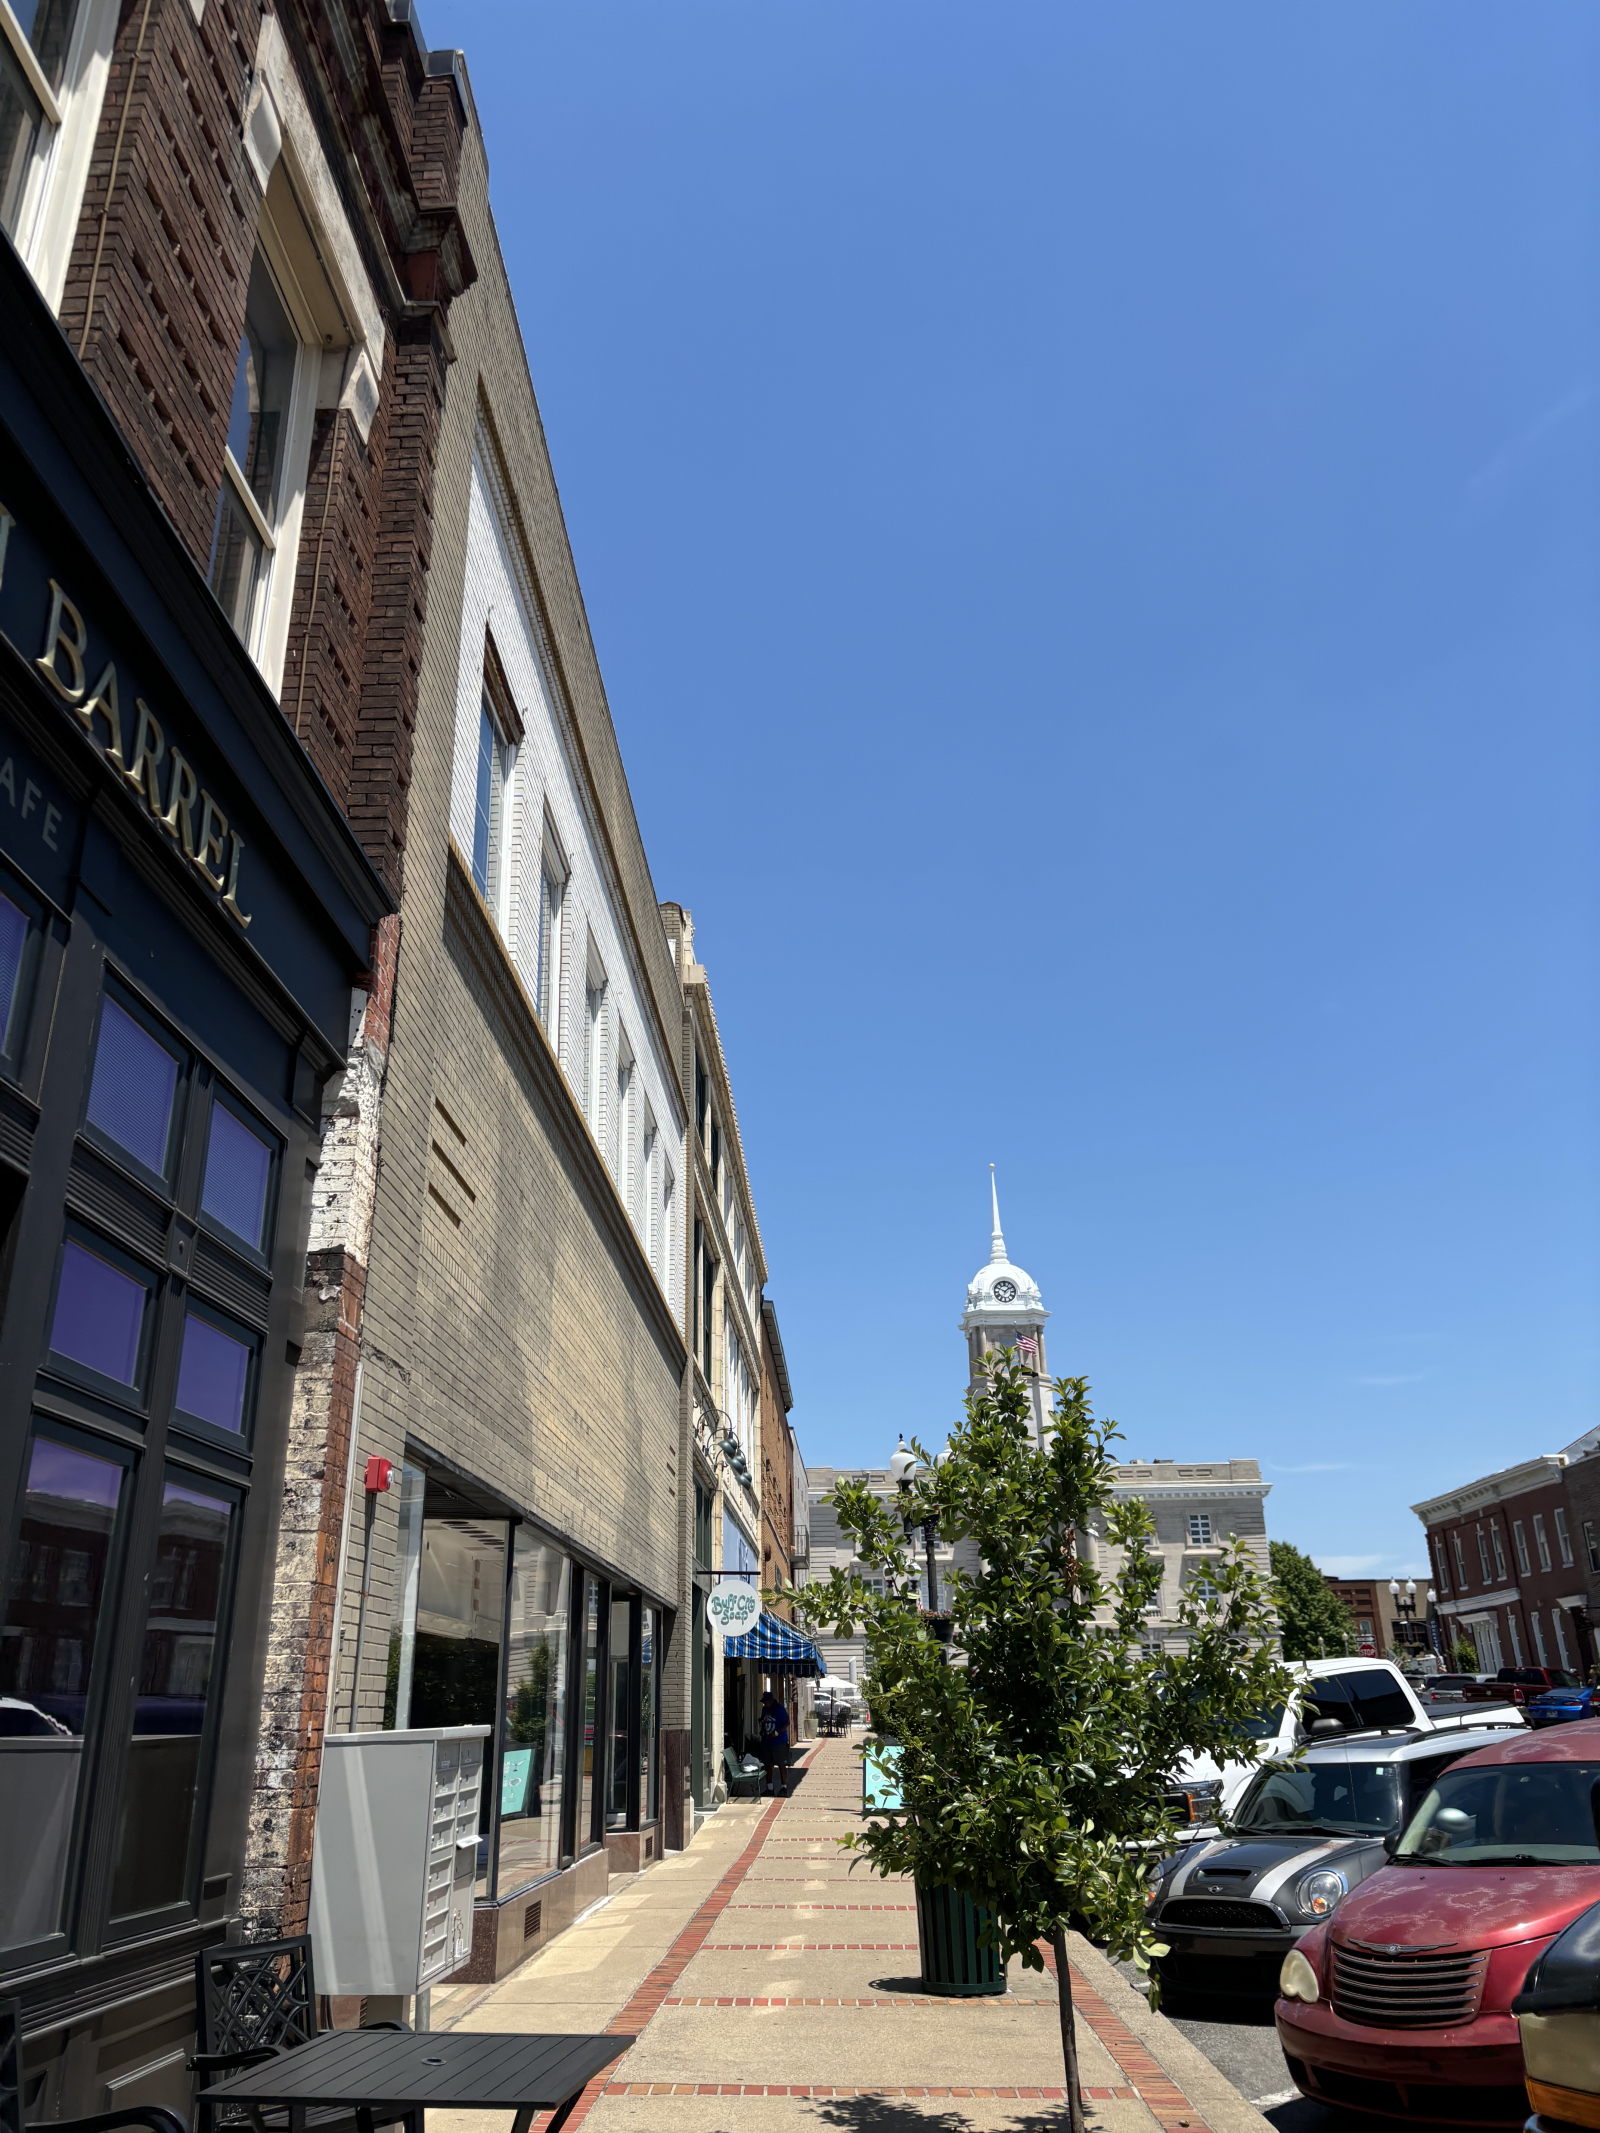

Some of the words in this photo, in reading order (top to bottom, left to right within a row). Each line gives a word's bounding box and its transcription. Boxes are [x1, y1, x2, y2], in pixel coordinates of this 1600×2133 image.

[35, 578, 252, 929] BARREL
[711, 1593, 737, 1615] Buff
[737, 1594, 755, 1613] City
[720, 1609, 748, 1625] Soap
[1361, 1648, 1376, 1656] STOP
